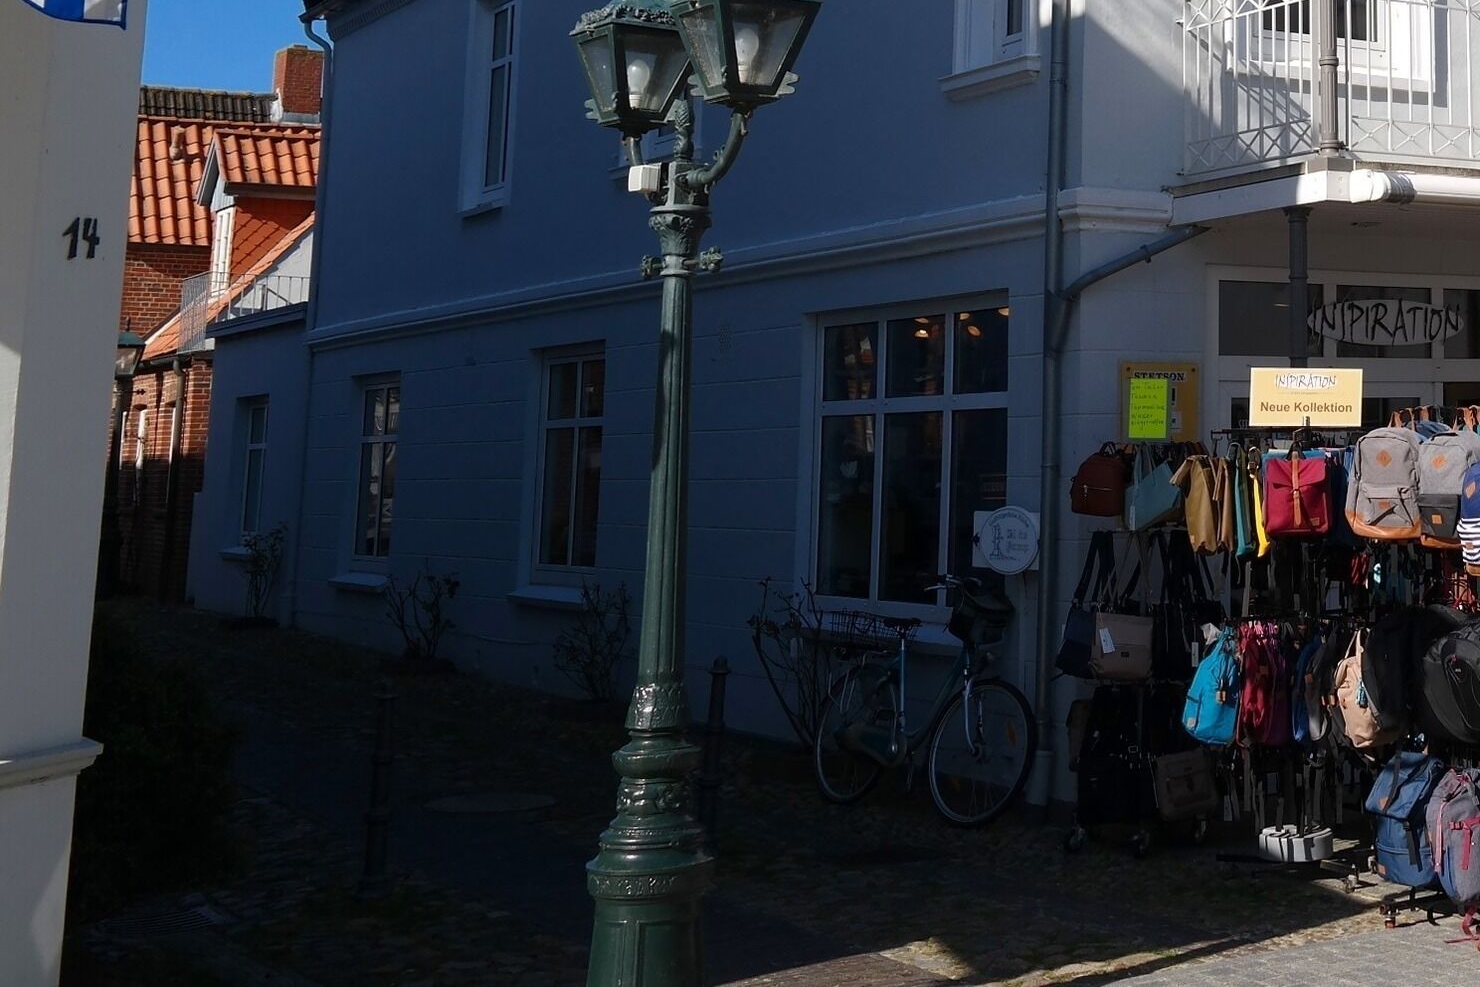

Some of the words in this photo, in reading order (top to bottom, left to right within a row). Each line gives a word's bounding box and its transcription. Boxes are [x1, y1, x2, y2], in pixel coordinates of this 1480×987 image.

[62, 217, 100, 260] 14
[1312, 298, 1459, 346] INSPIRATION
[1275, 373, 1337, 389] INSPIRATION
[1260, 401, 1290, 412] Neue
[1294, 401, 1353, 412] Kollektion
